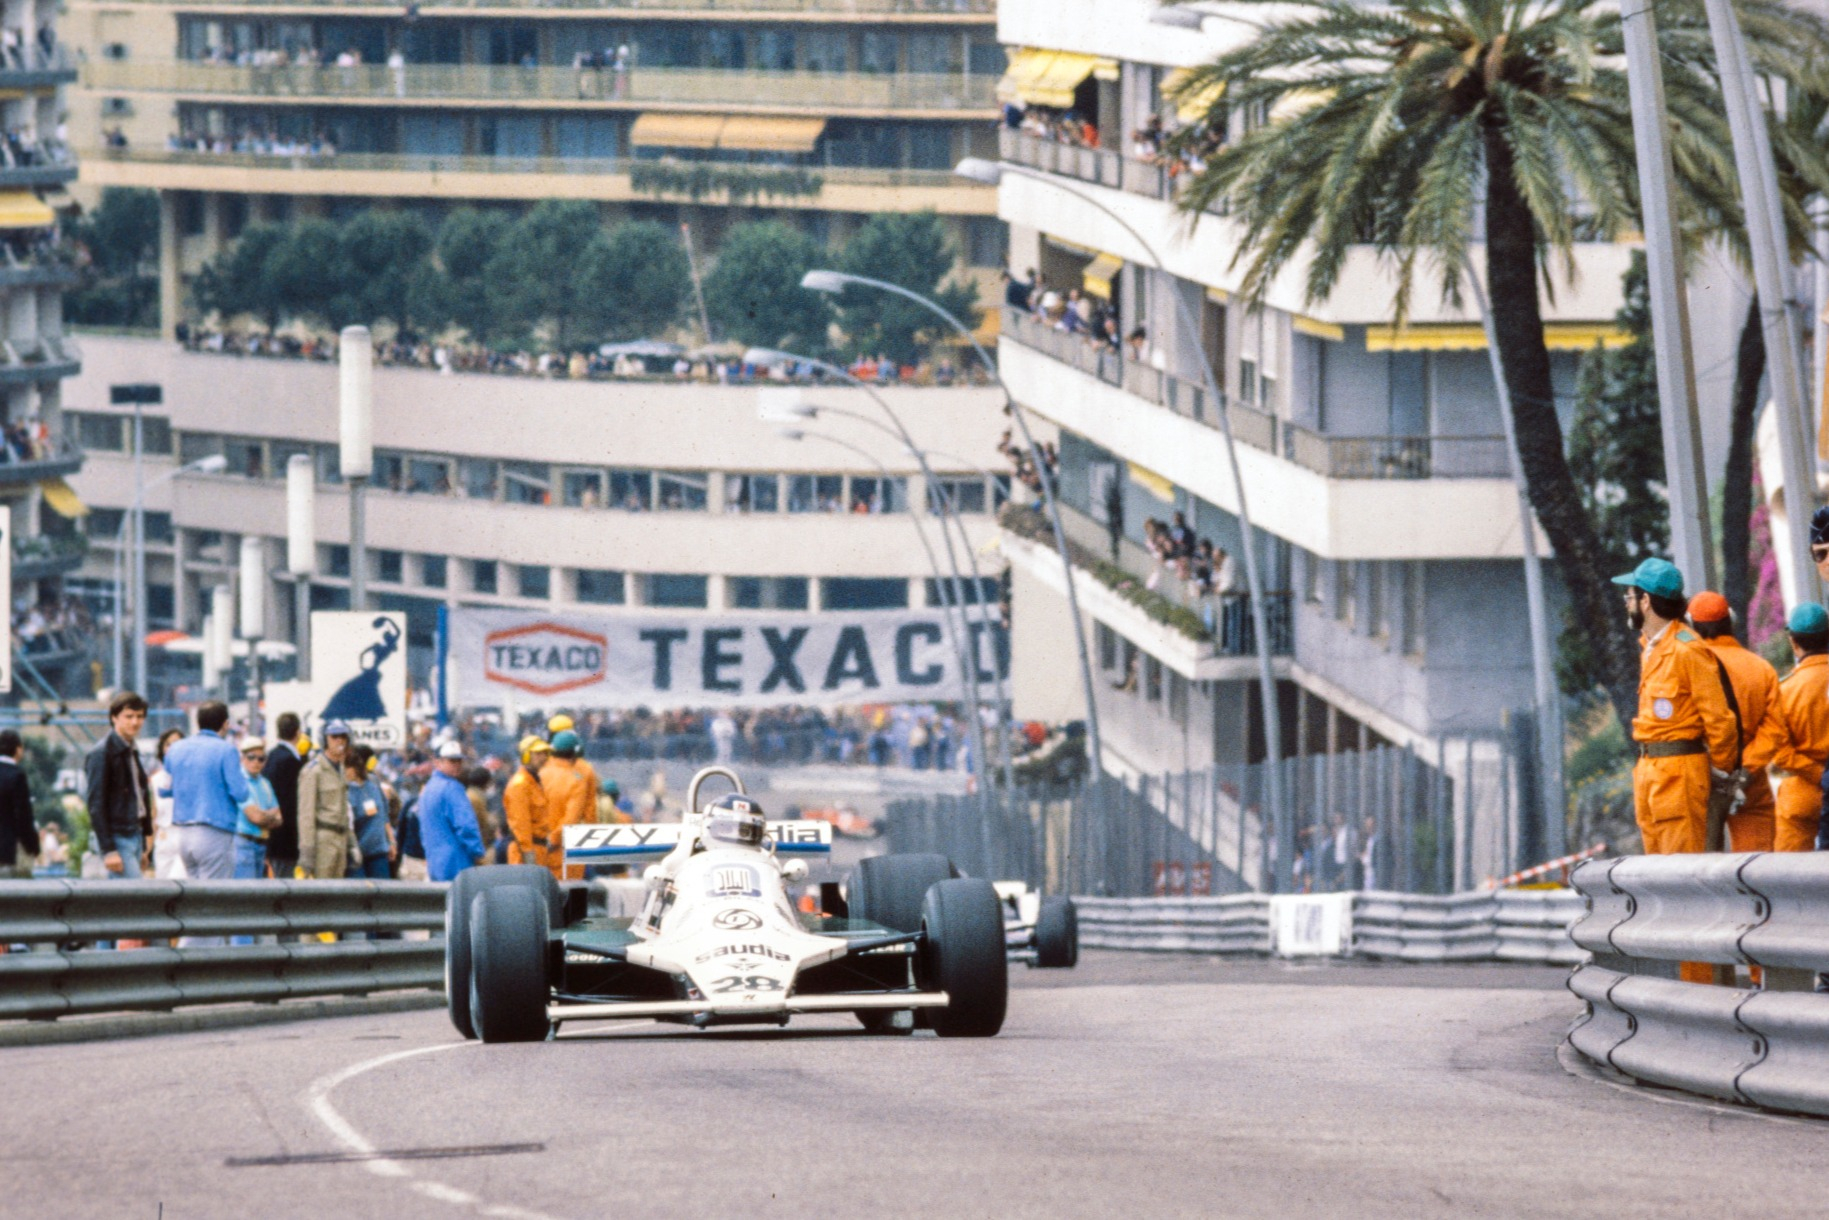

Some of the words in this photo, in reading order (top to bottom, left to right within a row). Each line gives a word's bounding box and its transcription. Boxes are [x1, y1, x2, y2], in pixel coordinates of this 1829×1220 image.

[491, 644, 601, 671] TEXACO
[639, 622, 1012, 693] TEXACO
[575, 828, 659, 847] FLY
[694, 944, 792, 965] saudia
[711, 975, 785, 994] 28
